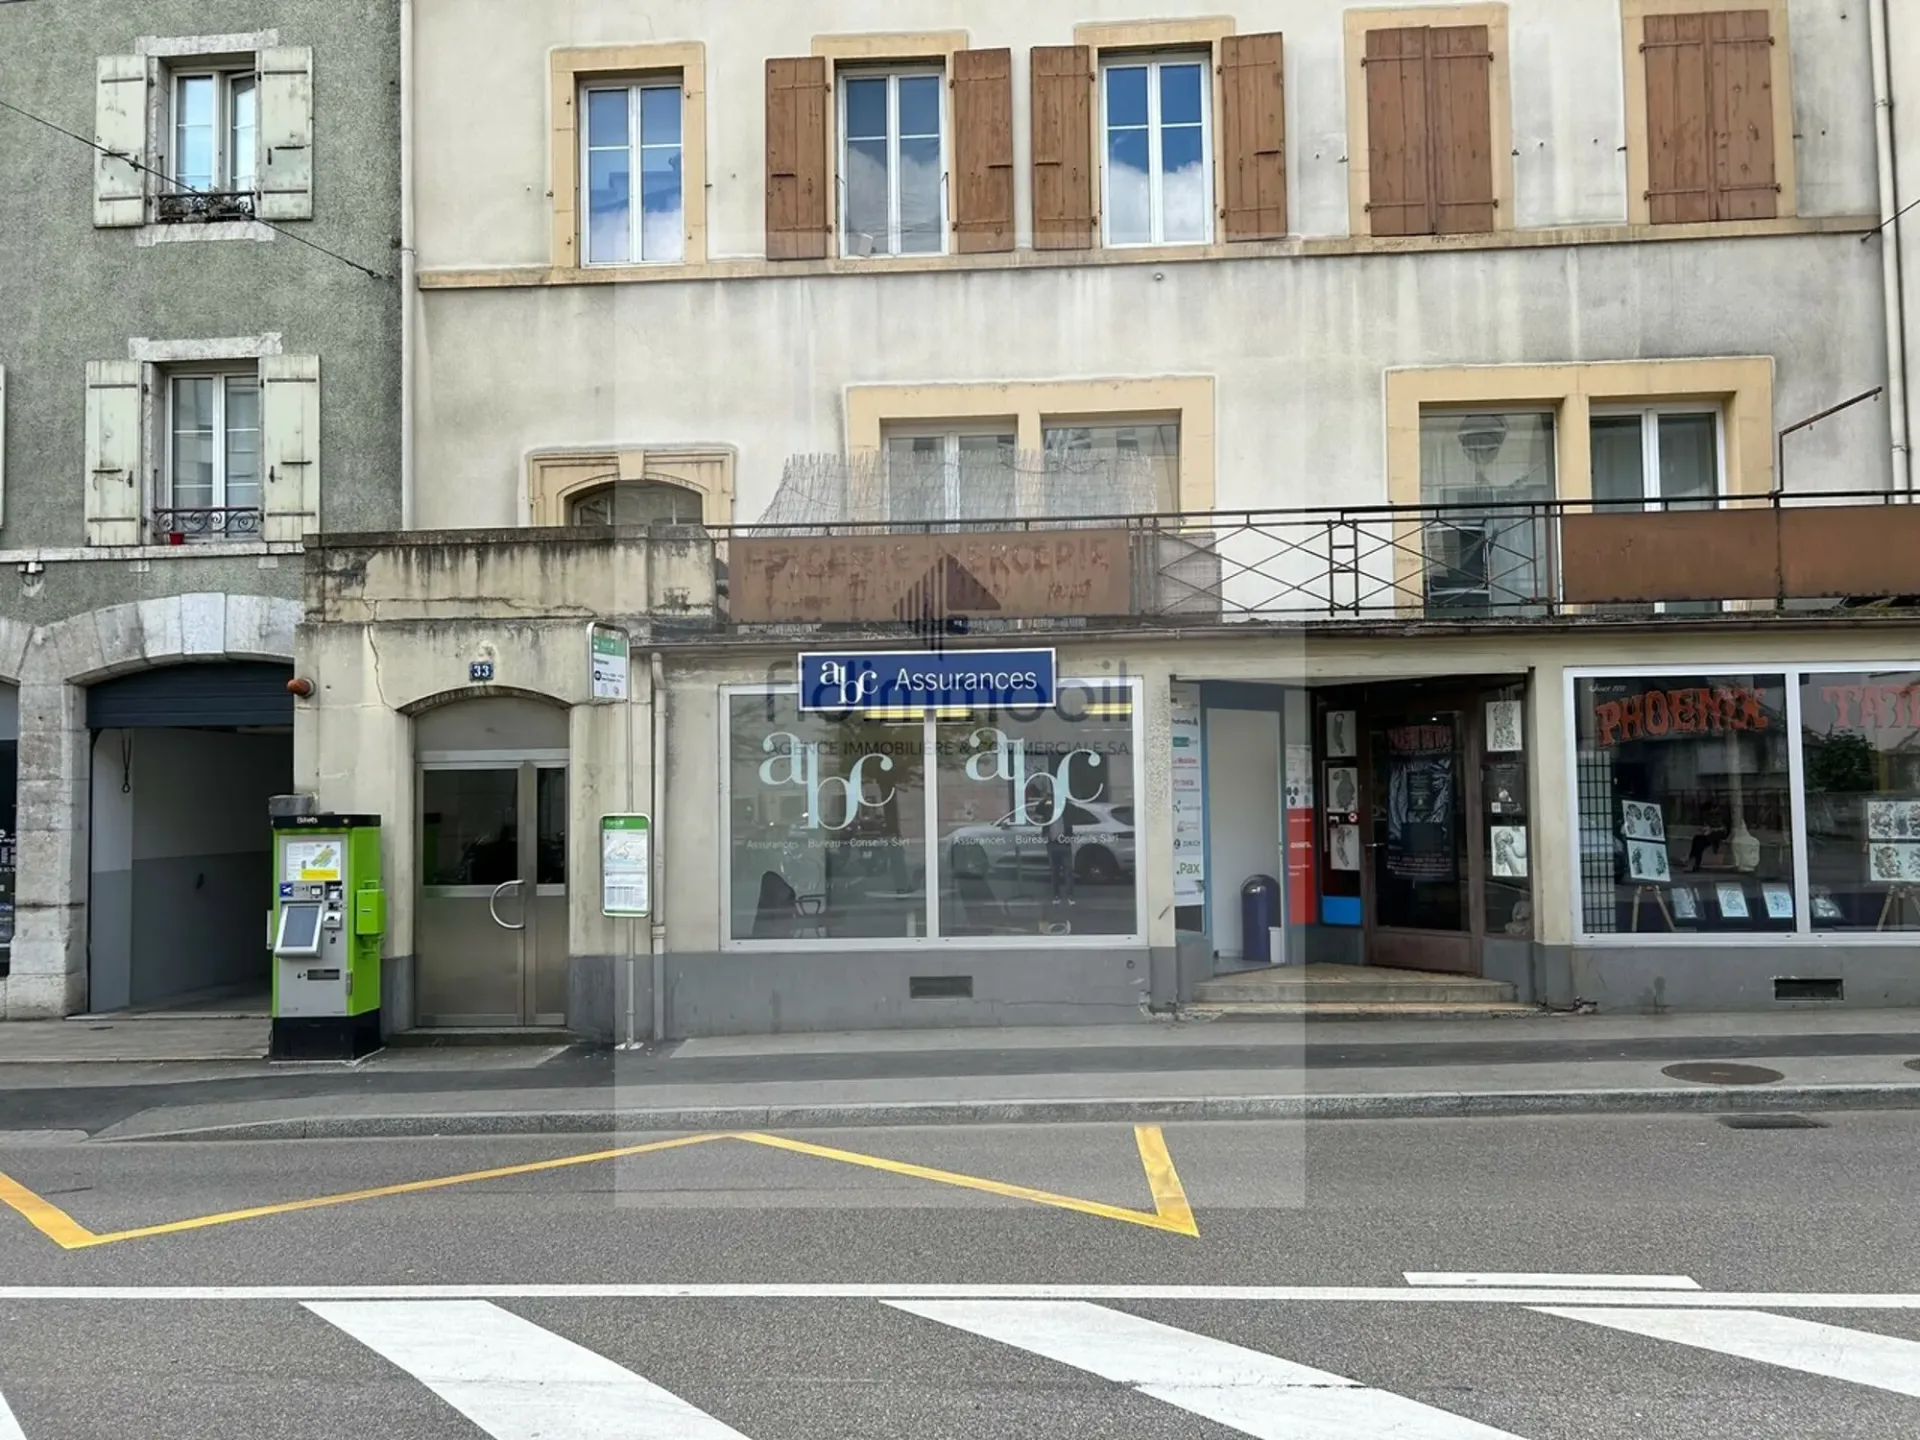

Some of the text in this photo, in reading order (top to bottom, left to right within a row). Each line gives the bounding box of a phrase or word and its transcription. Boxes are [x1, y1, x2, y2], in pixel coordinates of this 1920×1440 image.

[473, 664, 490, 677] 33
[819, 660, 1038, 704] abc Assurances
[1595, 687, 1770, 747] PHOENIX
[759, 731, 896, 830] abc
[965, 727, 1104, 826] abc
[953, 835, 1006, 845] Assurances
[1015, 834, 1049, 845] Bureau
